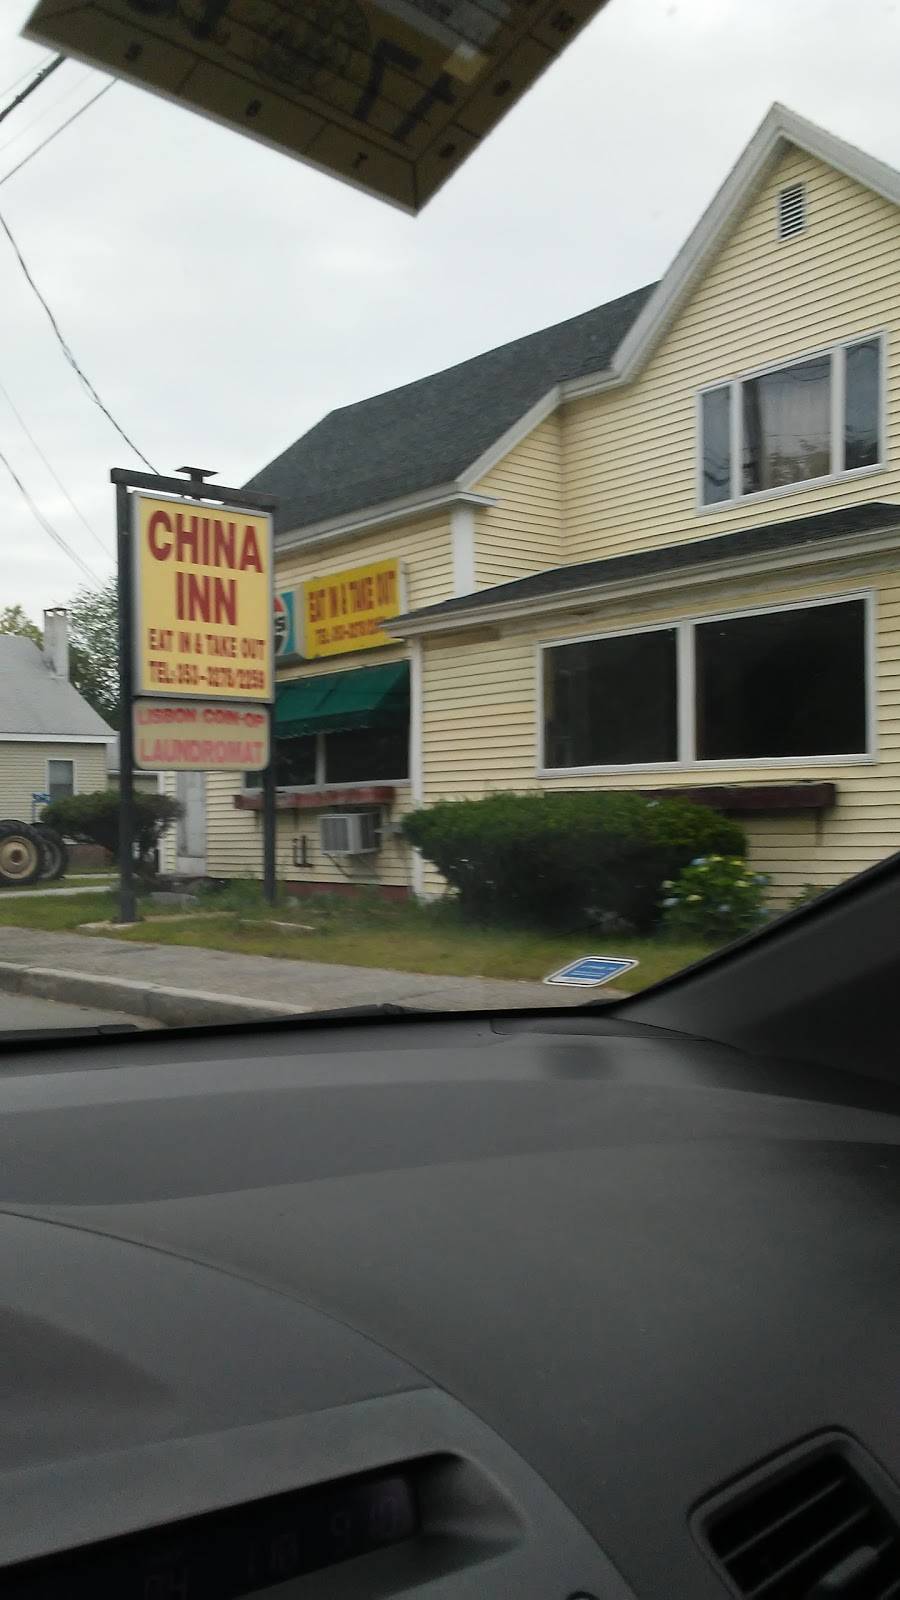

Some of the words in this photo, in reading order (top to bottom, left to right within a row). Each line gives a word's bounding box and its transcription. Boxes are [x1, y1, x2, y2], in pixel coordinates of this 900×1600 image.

[147, 510, 264, 574] CHINA
[175, 571, 238, 626] INN
[147, 628, 173, 652] EAT
[177, 631, 192, 654] IN
[194, 632, 203, 655] &
[206, 634, 237, 658] TAKE
[241, 638, 265, 661] OUT
[136, 708, 197, 726] LISBON
[140, 738, 264, 764] LAUNDROMAT
